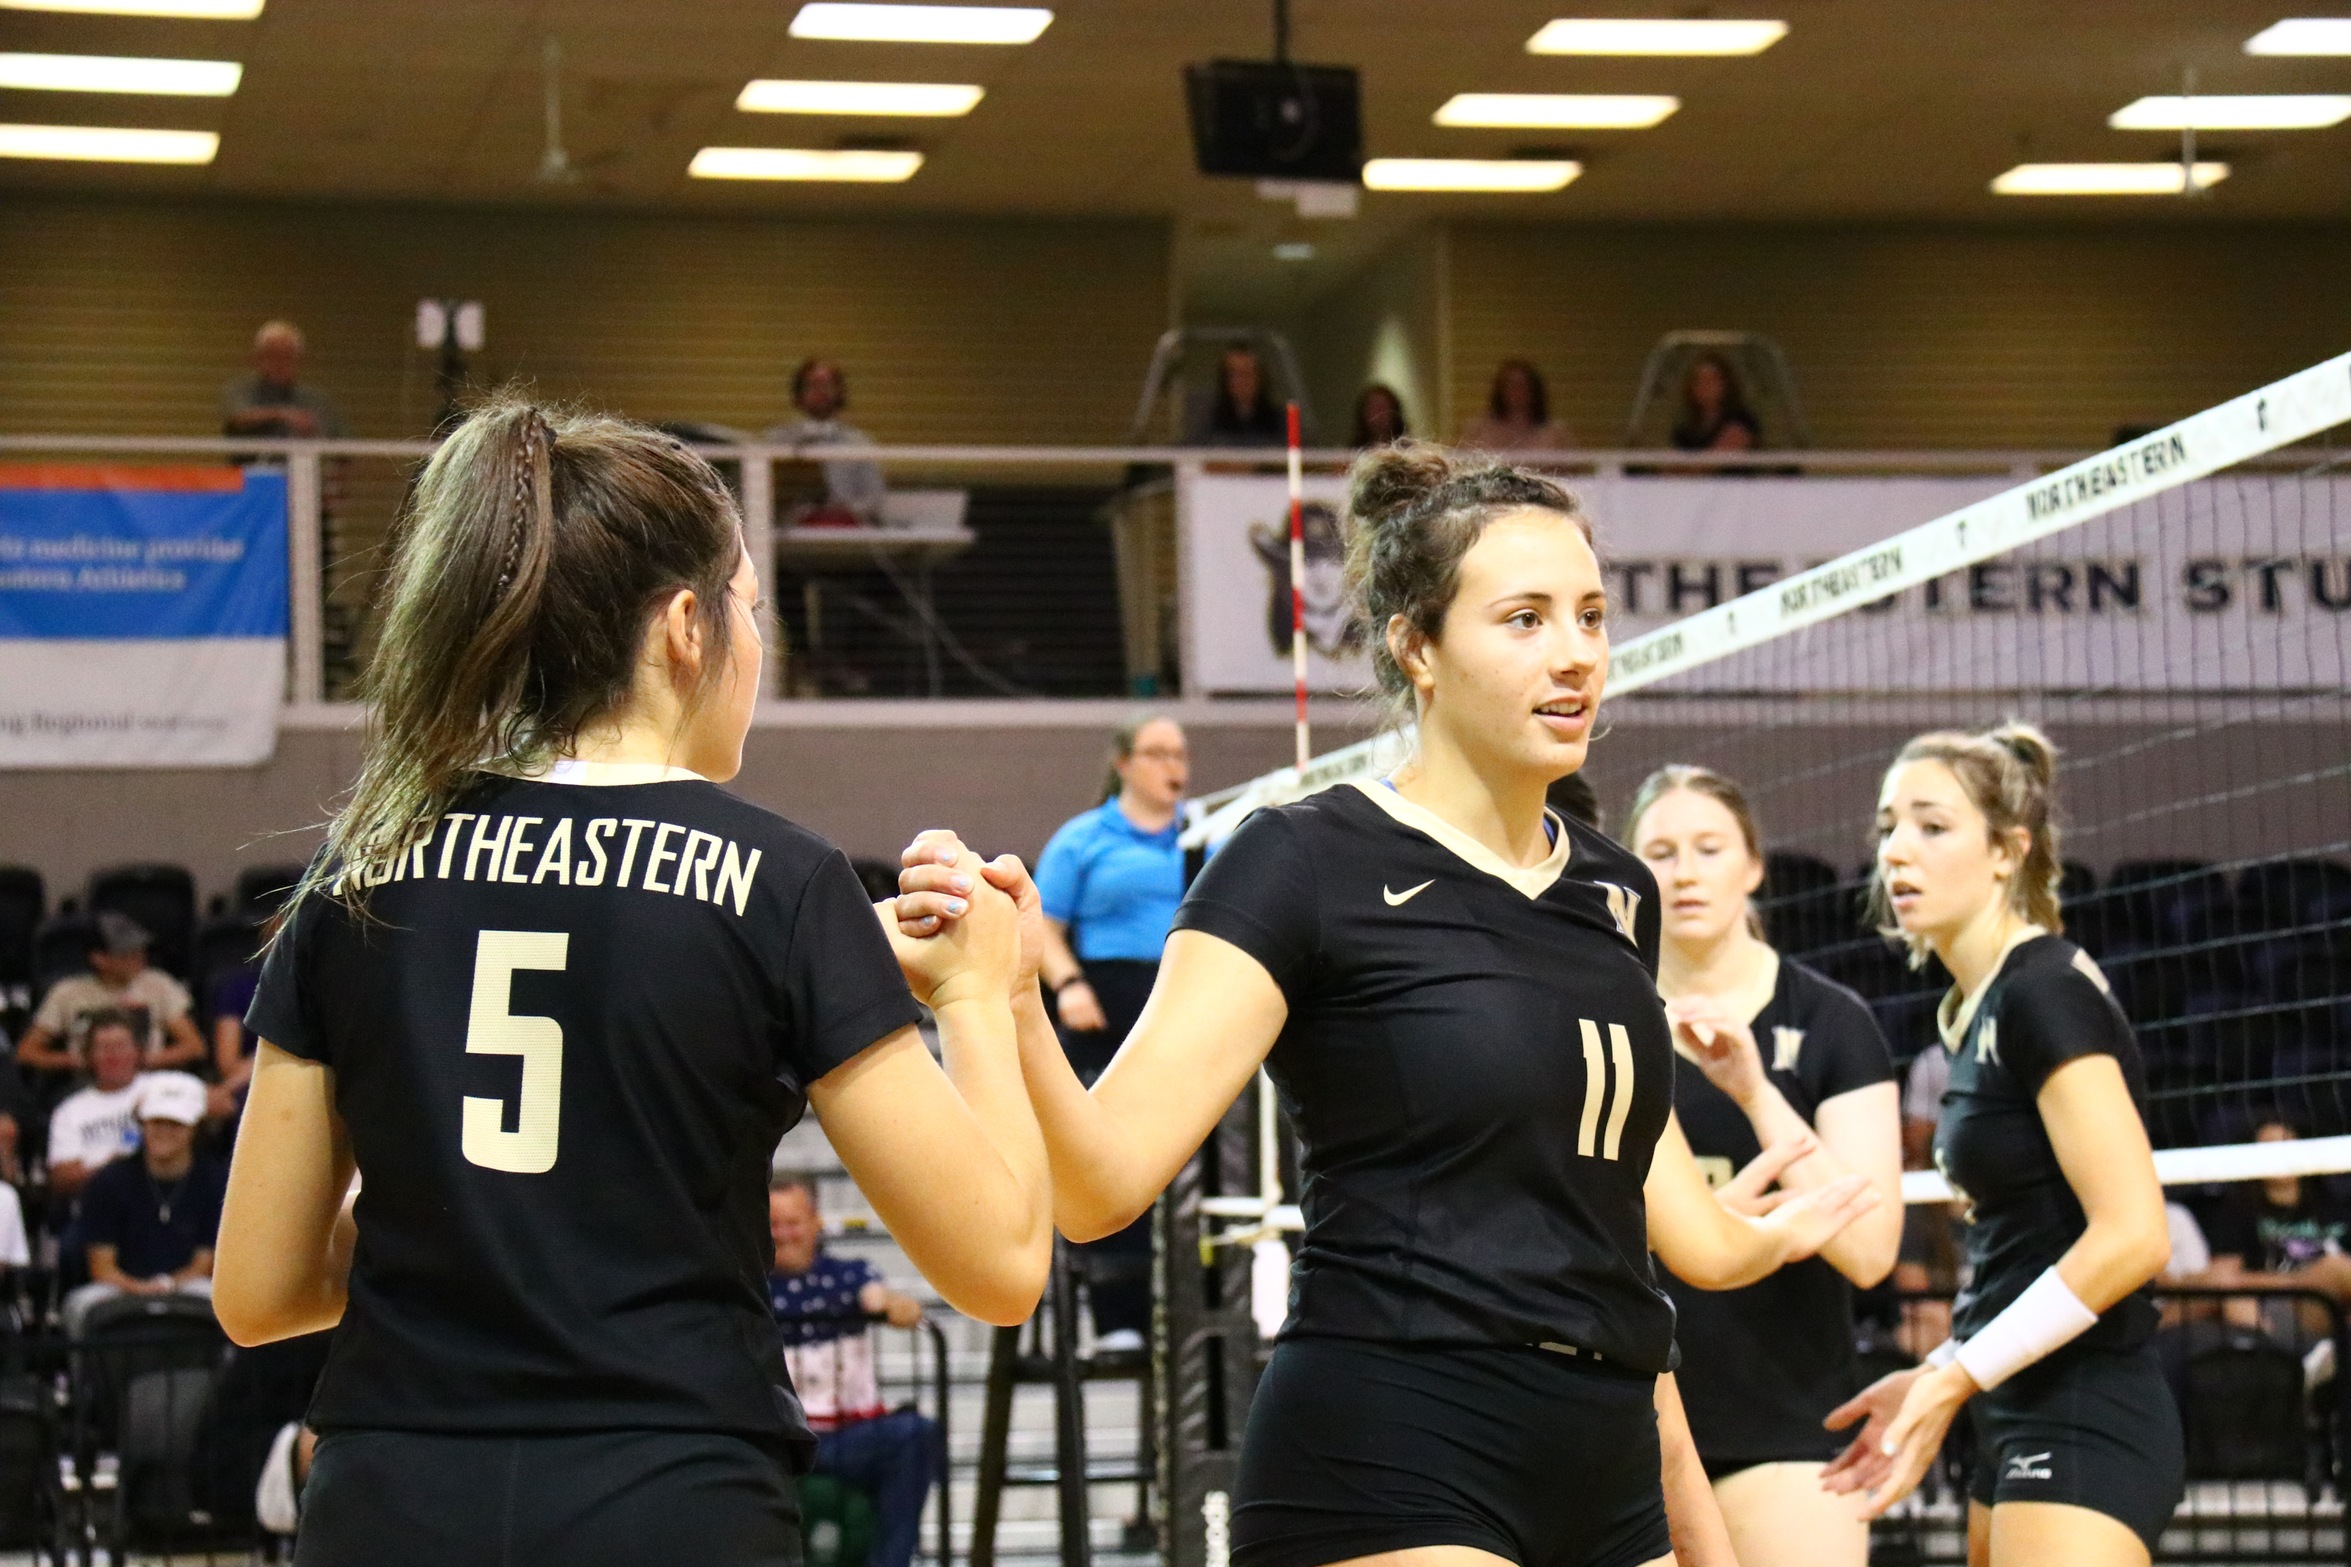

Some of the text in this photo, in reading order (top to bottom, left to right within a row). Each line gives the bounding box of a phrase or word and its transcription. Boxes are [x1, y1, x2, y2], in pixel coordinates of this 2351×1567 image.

[2025, 432, 2187, 521] NORTHEASTERN
[461, 929, 570, 1174] 5
[1577, 1018, 1635, 1161] 11
